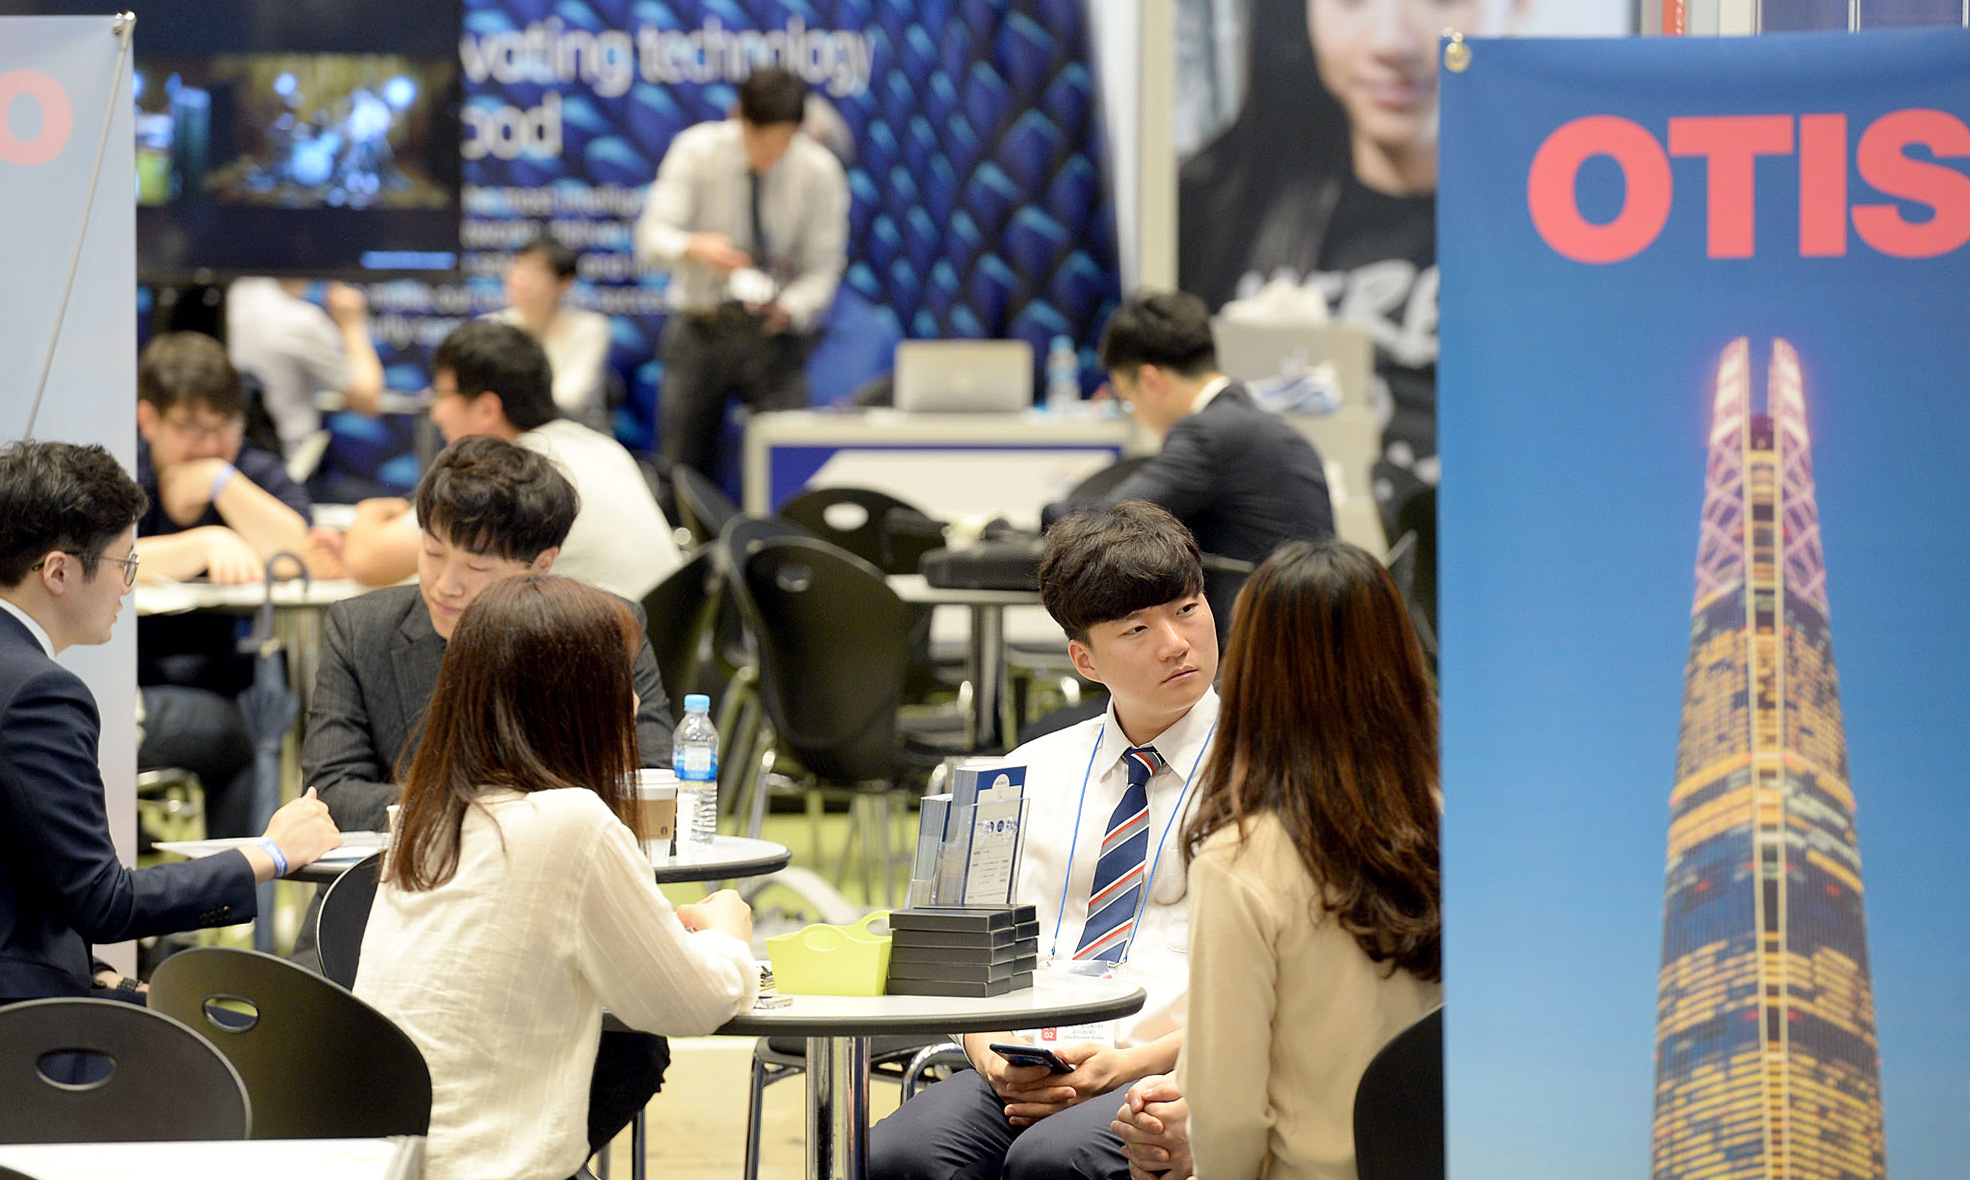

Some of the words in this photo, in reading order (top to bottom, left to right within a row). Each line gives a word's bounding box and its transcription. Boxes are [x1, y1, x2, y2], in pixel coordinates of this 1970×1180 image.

[640, 15, 873, 96] technology
[1528, 108, 1970, 264] OTIS
[1044, 1031, 1054, 1039] 02
